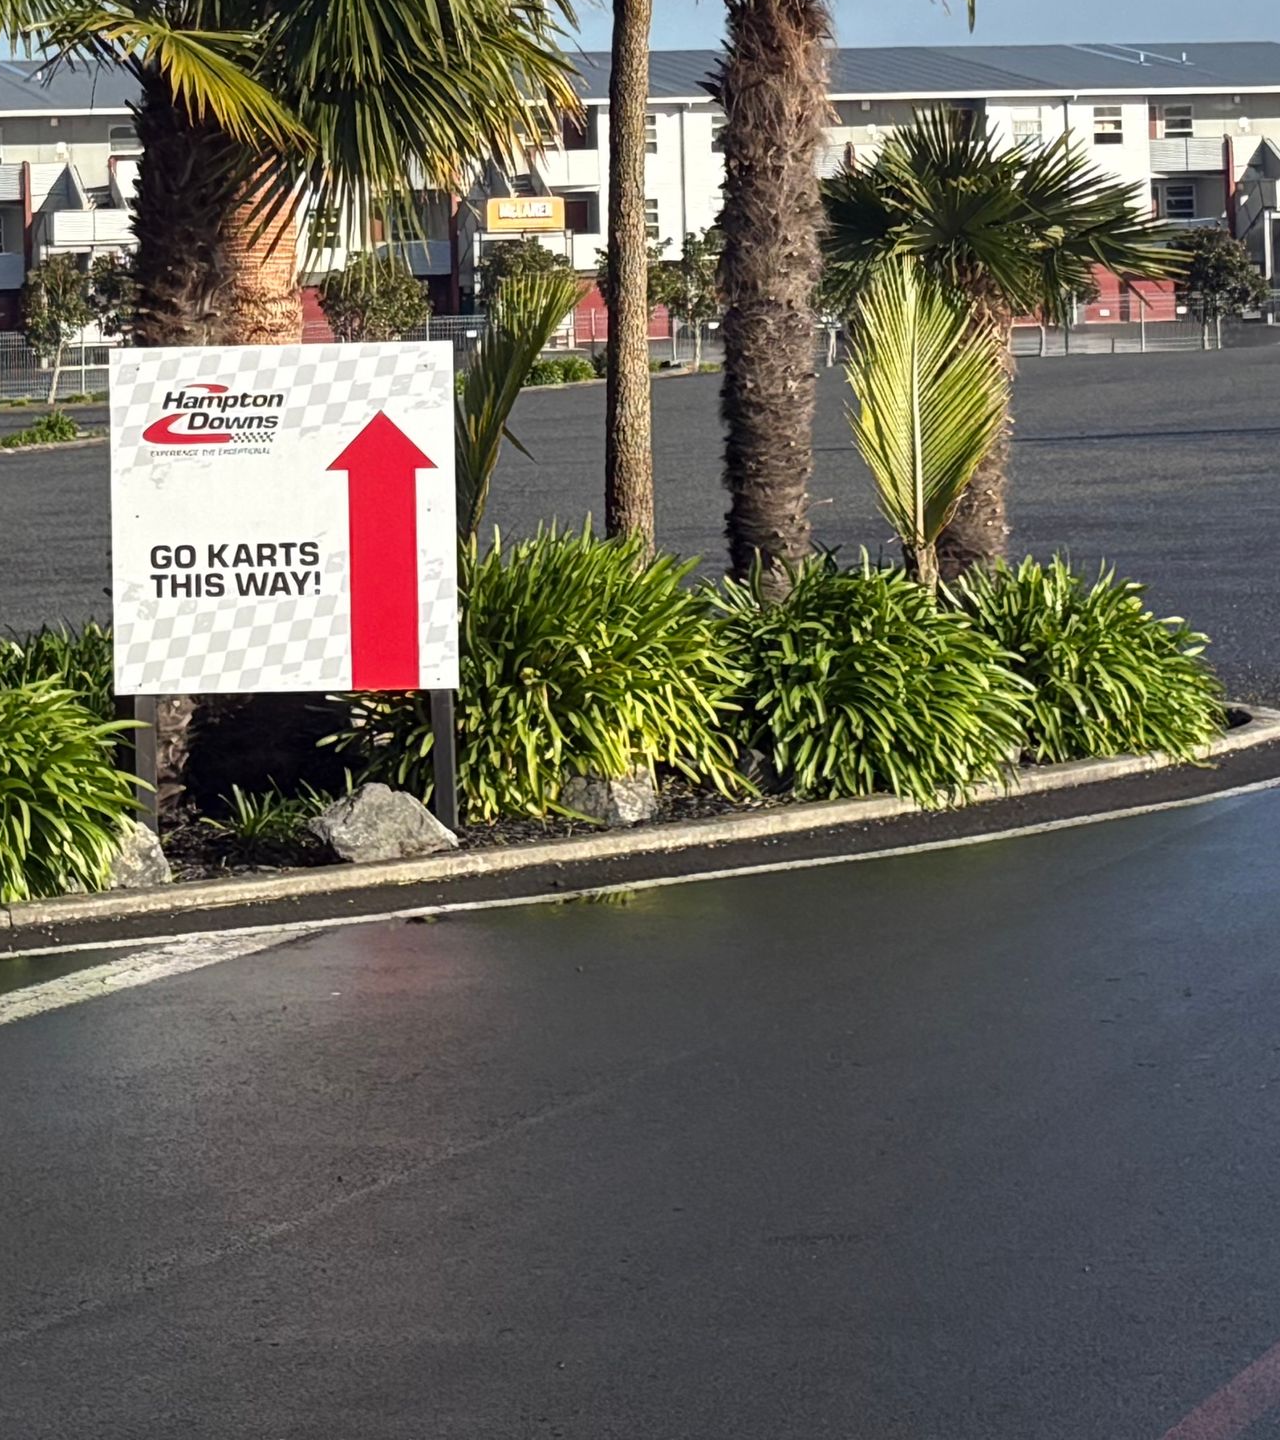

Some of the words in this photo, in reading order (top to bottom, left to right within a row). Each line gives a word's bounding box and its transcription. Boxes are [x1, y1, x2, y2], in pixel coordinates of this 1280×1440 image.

[162, 391, 284, 413] Hampton
[187, 412, 279, 430] Downs
[150, 544, 197, 569] GO
[208, 541, 320, 568] KARTS
[150, 572, 226, 598] THIS
[235, 570, 321, 597] WAY!
